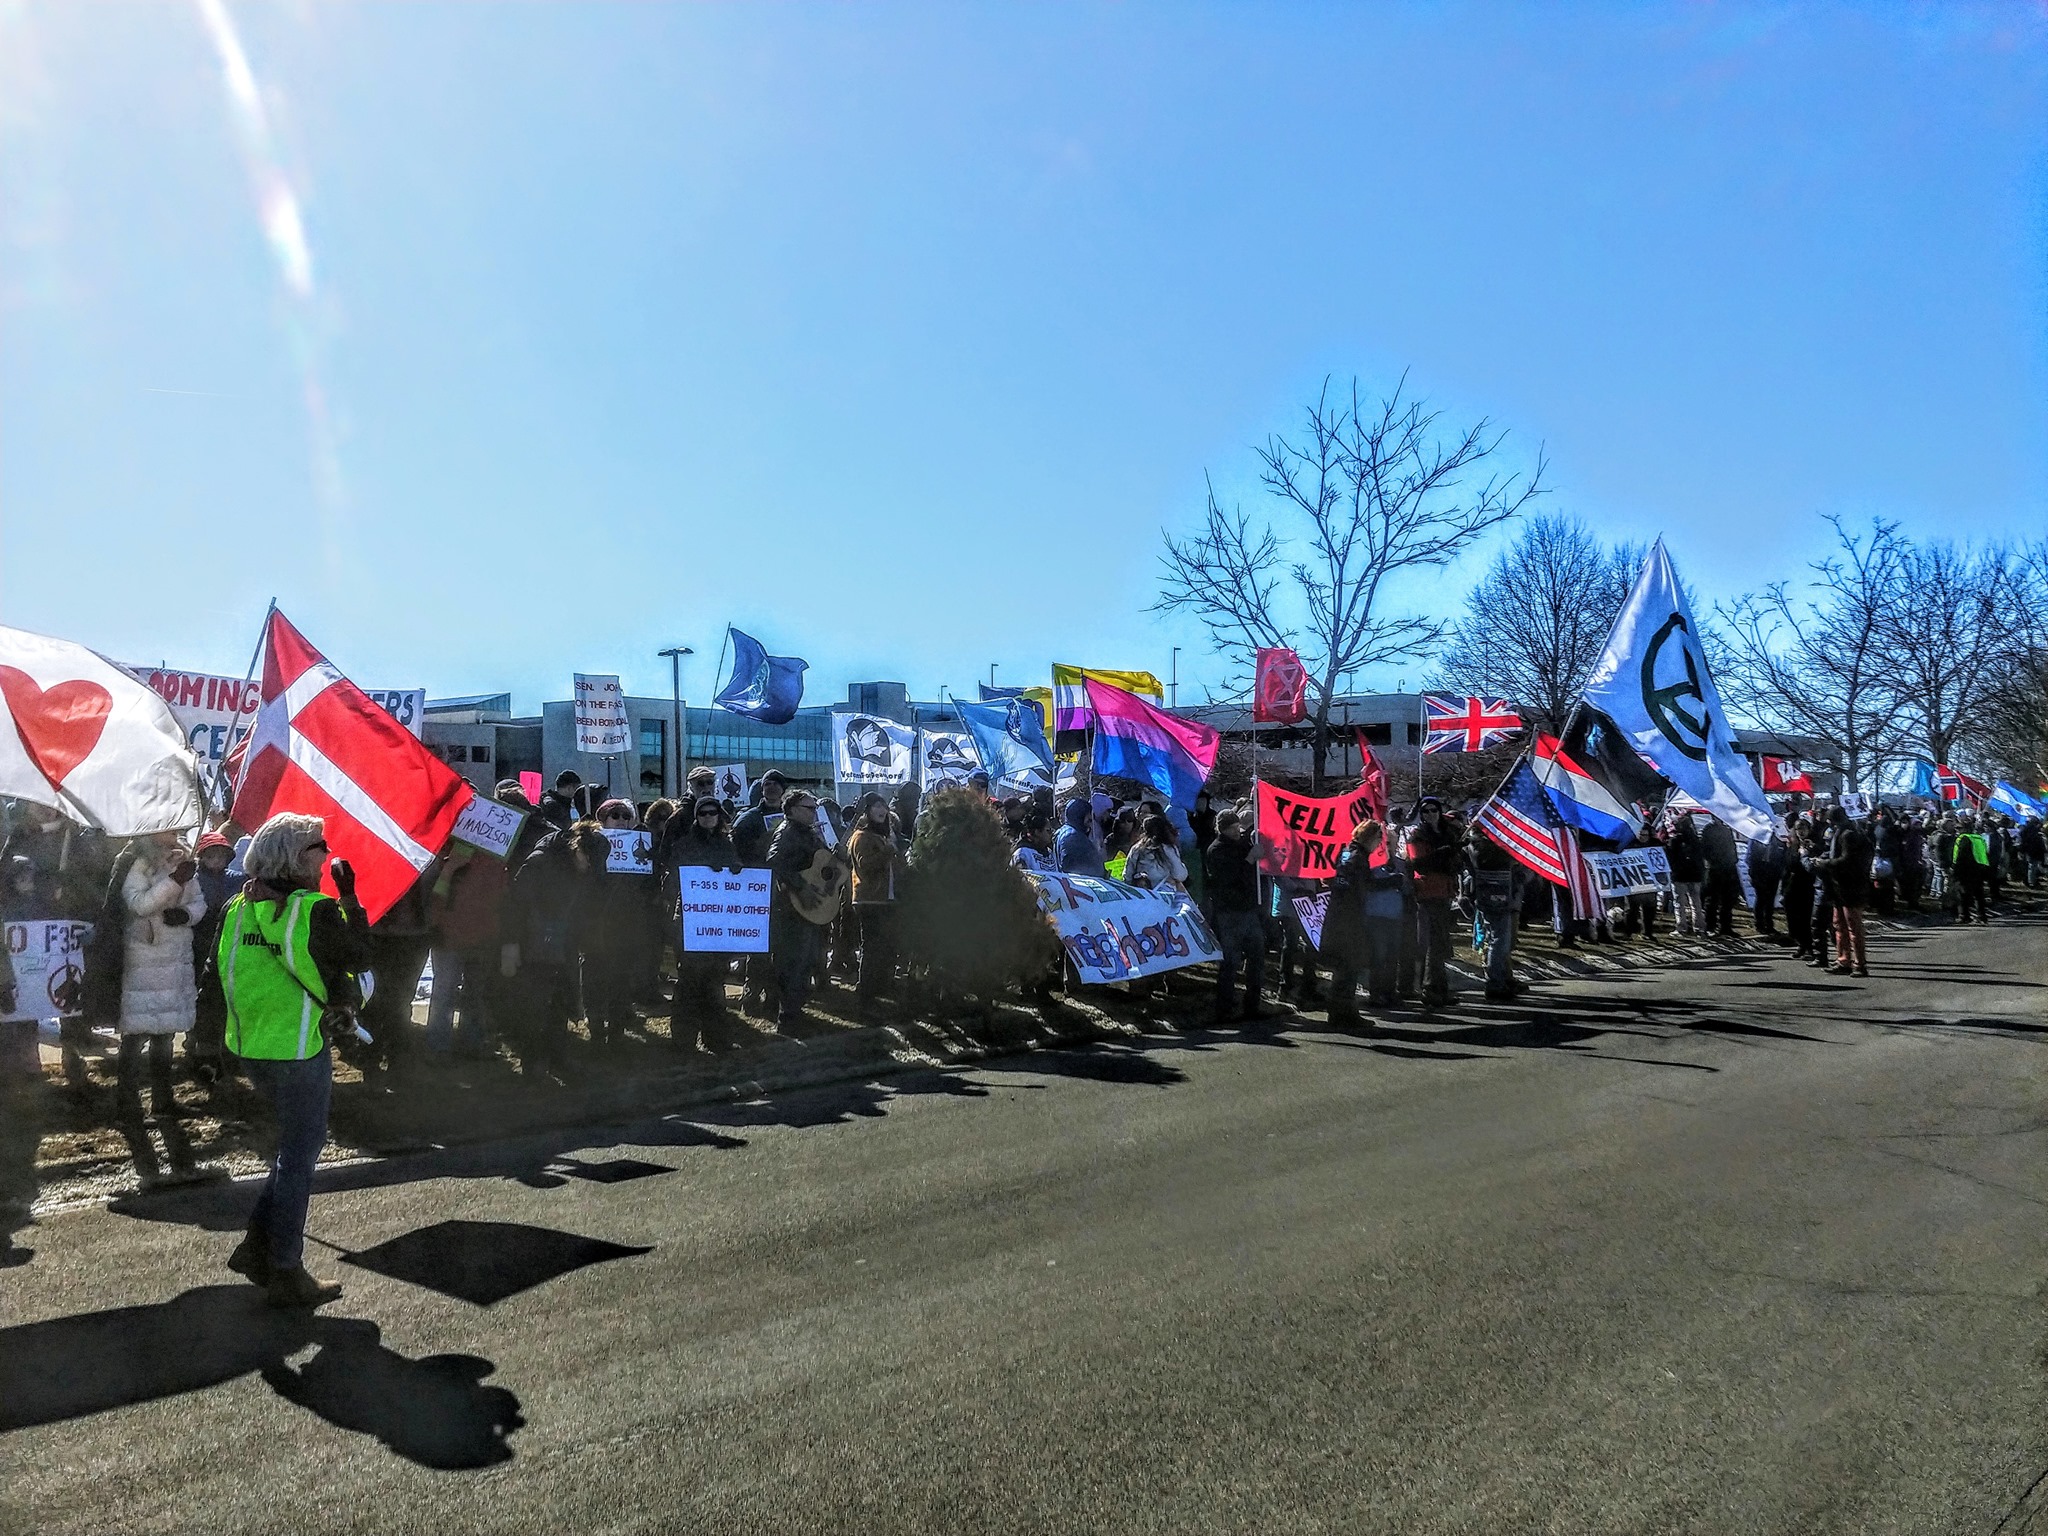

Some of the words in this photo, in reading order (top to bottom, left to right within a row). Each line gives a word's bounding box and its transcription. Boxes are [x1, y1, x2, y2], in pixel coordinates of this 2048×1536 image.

[575, 682, 594, 692] SEN.
[575, 700, 587, 709] ON
[589, 700, 607, 709] THE
[576, 717, 597, 726] BEEN
[580, 735, 599, 744] AND
[487, 805, 514, 826] F-35
[1274, 795, 1336, 837] TELL
[609, 839, 624, 849] NO
[1597, 863, 1655, 891] DANE
[724, 881, 742, 892] BAD
[747, 882, 767, 893] FOR
[682, 903, 724, 914] CHILDREN
[725, 904, 743, 915] AND
[743, 905, 770, 916] OTHER
[1293, 898, 1314, 919] NO
[696, 927, 724, 937] LIVING
[727, 928, 761, 938] THINGS!
